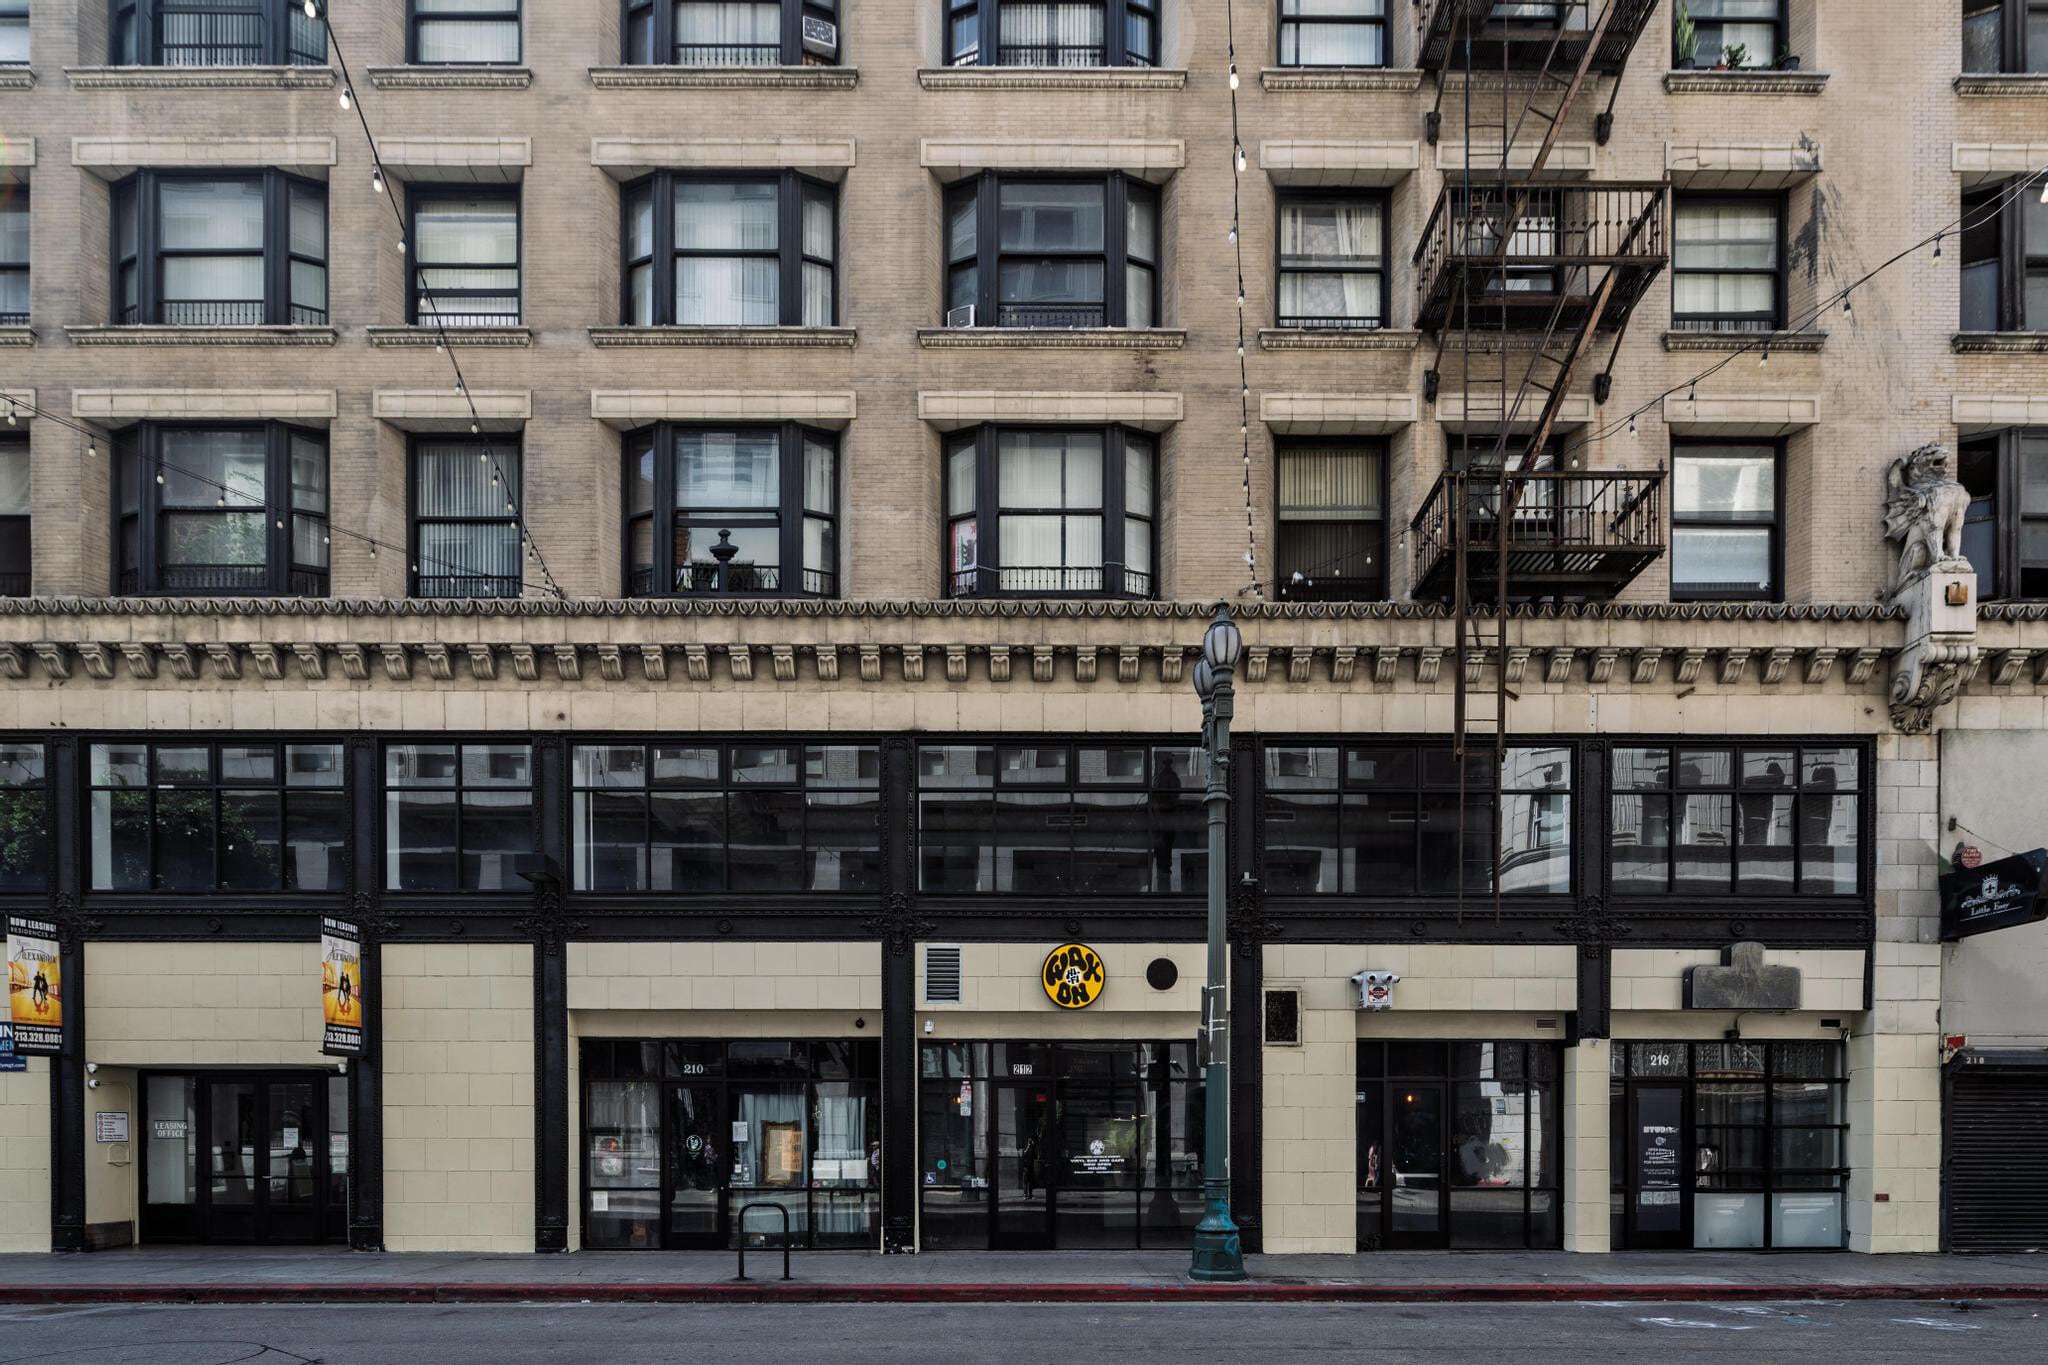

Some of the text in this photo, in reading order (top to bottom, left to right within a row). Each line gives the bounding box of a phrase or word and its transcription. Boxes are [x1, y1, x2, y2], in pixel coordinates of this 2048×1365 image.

[1970, 905, 1990, 916] Little
[10, 917, 57, 932] NOW LEASING!
[10, 926, 49, 938] RESIDENCES
[1046, 947, 1101, 986] WAX
[1057, 982, 1090, 1005] ON
[14, 1031, 62, 1044] 213.328.0881
[1650, 1054, 1669, 1066] 216
[684, 1063, 704, 1074] 210
[1013, 1063, 1033, 1075] 212
[155, 1122, 188, 1130] LEASING
[157, 1129, 185, 1137] OFFICE
